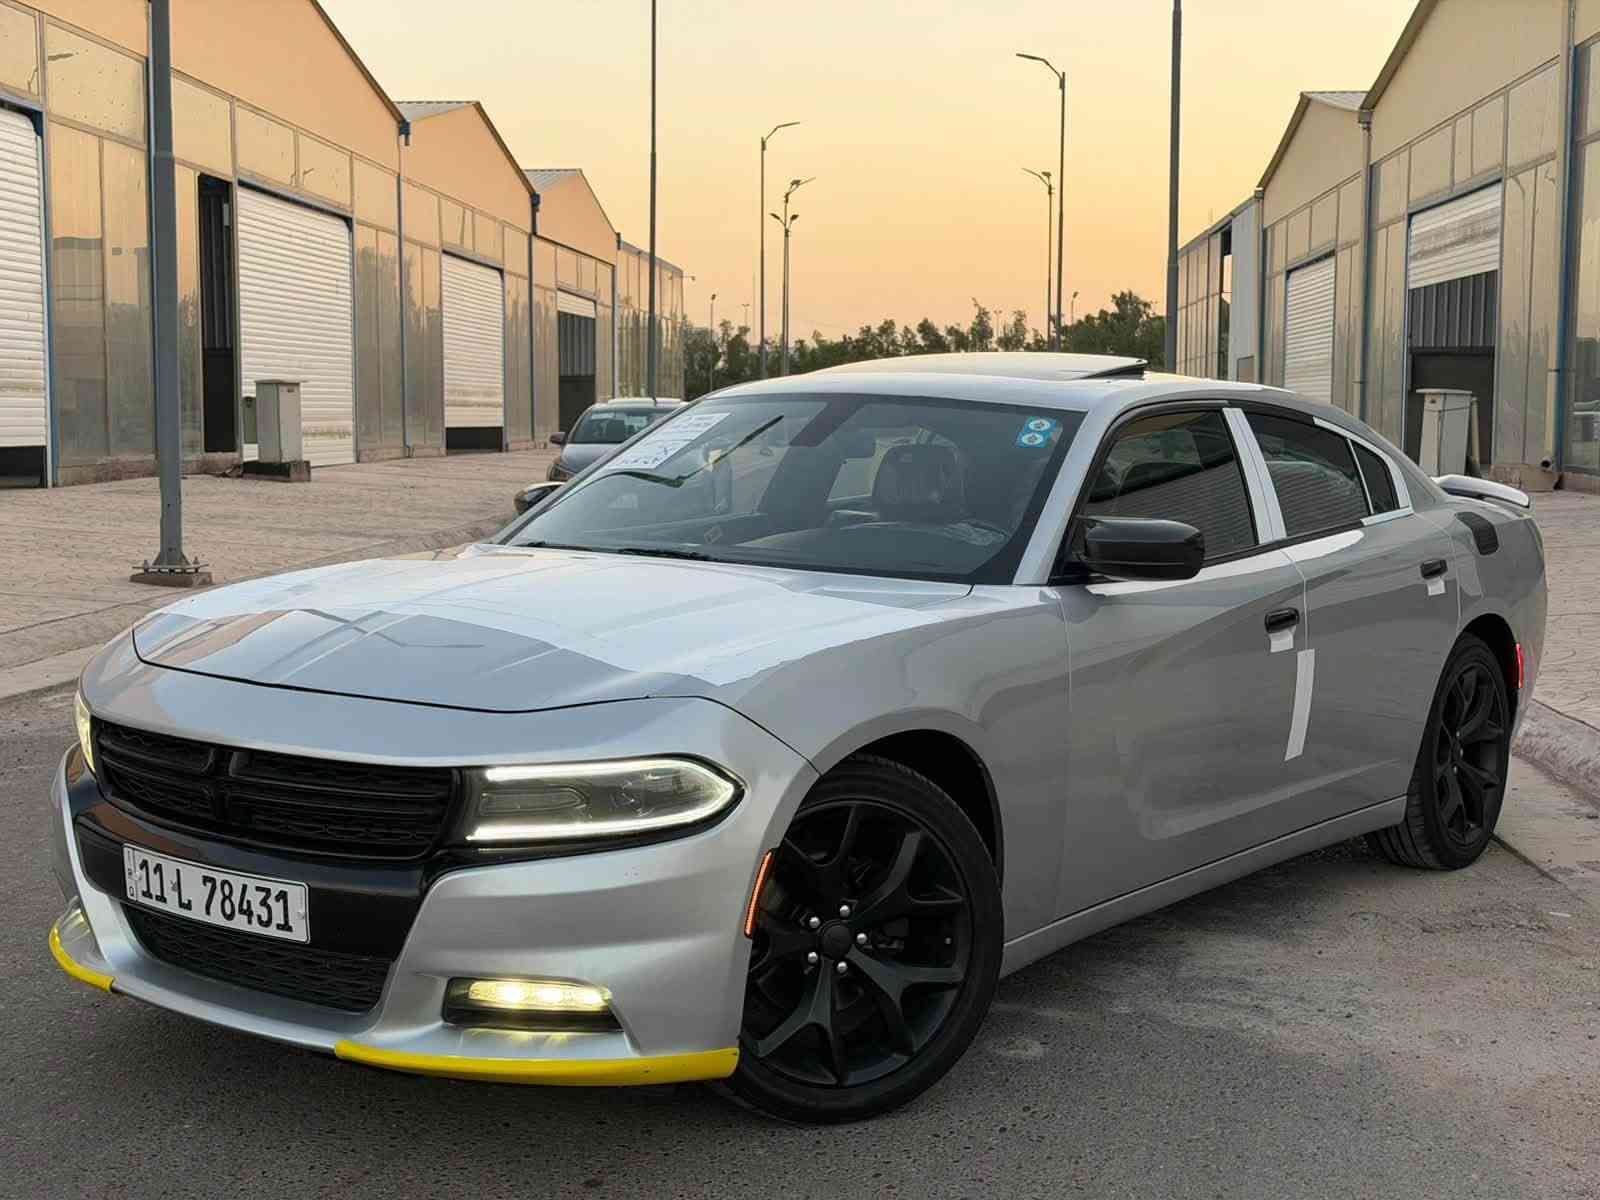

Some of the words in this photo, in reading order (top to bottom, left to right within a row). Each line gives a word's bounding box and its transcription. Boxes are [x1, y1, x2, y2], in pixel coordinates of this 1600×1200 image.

[139, 858, 167, 904] 11
[175, 868, 192, 911] L
[202, 875, 293, 932] 78431
